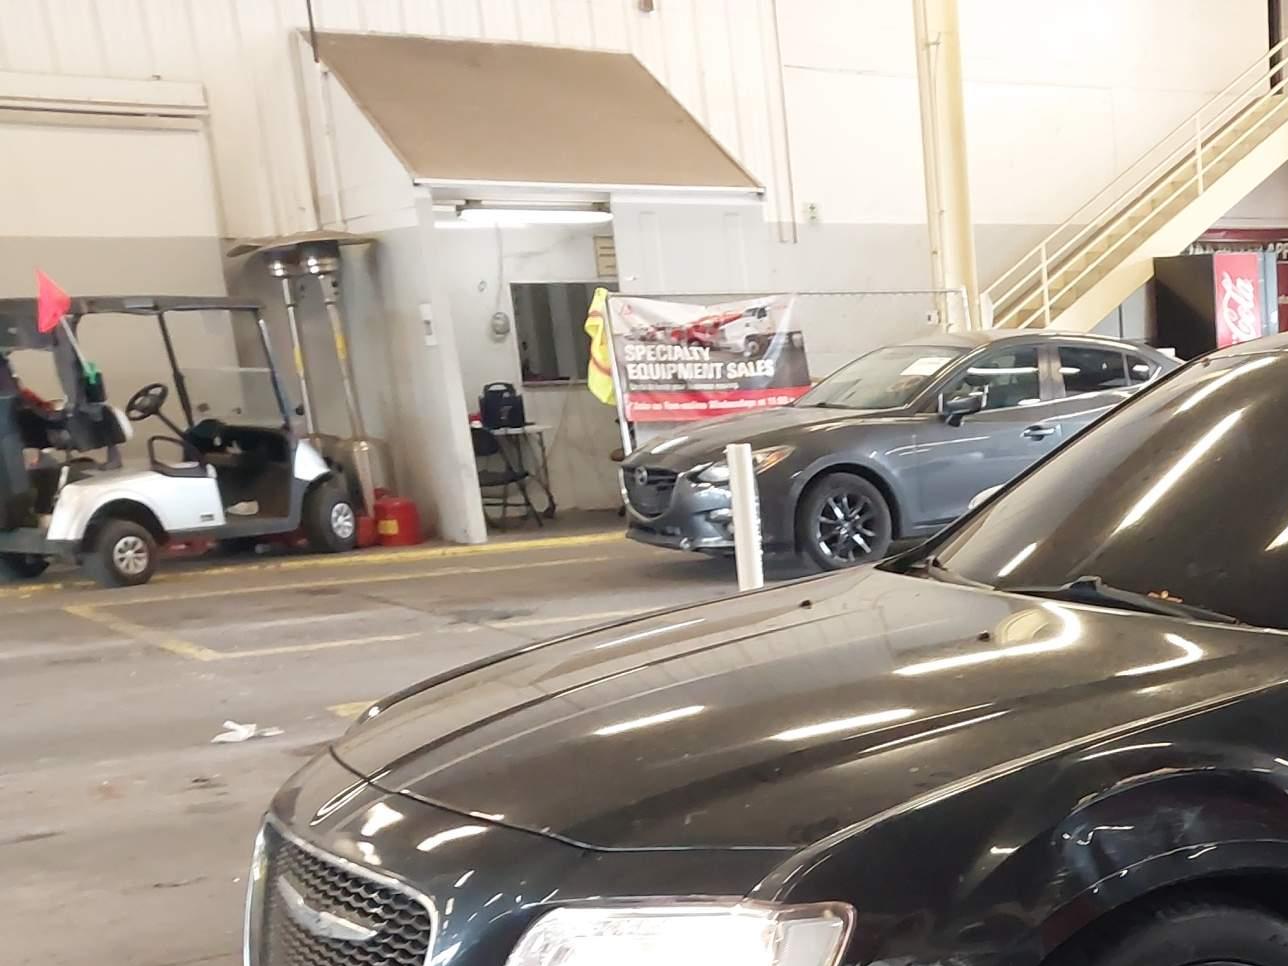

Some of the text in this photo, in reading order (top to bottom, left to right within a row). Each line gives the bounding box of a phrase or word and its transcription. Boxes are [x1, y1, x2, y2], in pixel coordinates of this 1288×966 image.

[624, 344, 710, 362] SPECIALTY
[626, 359, 775, 380] EQUIPMENT SALES
